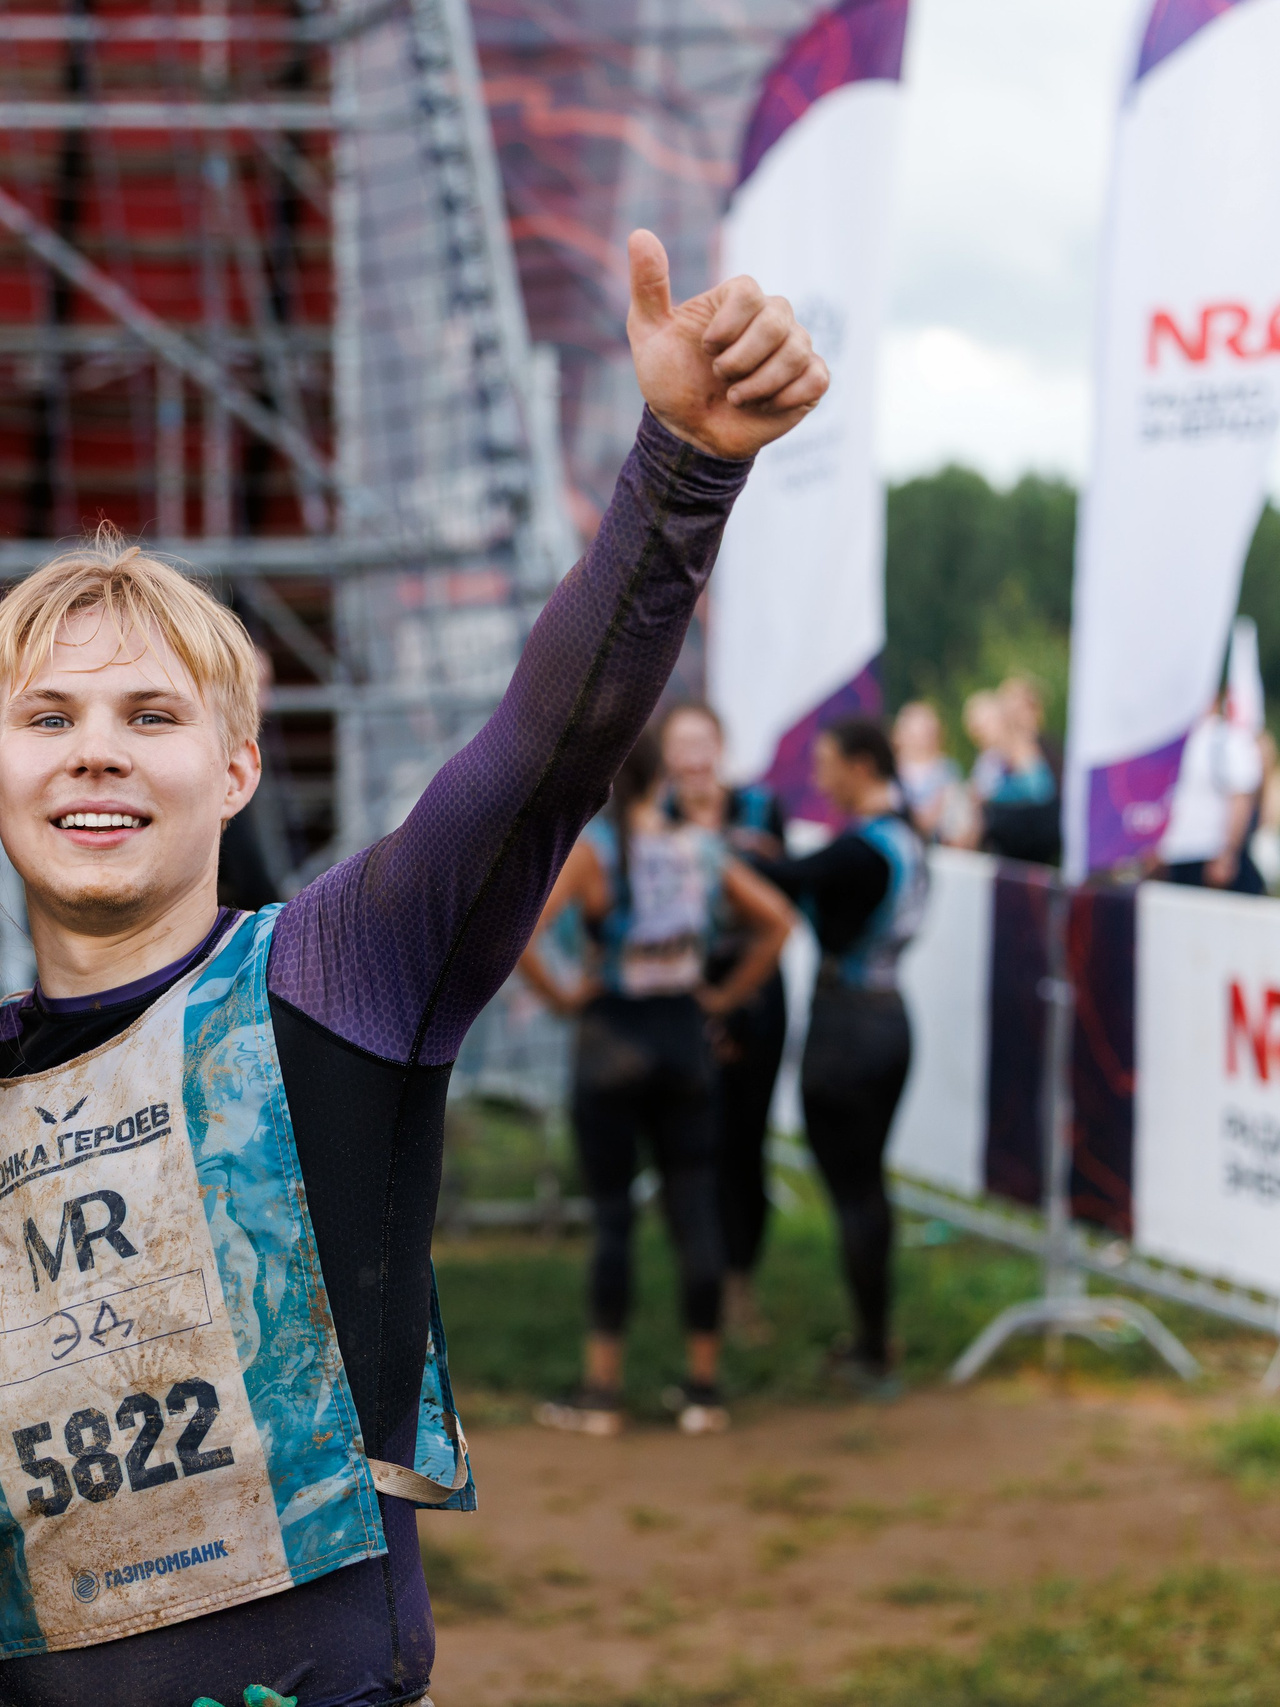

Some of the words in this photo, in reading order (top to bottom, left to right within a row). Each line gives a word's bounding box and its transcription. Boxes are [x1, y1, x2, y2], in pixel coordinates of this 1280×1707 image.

[1146, 303, 1280, 371] NR
[56, 1102, 171, 1159] ГЕРОЕВ
[22, 1190, 140, 1293] MR
[46, 1300, 135, 1361] ЭД
[11, 1377, 236, 1519] 5822
[104, 1540, 229, 1590] ГАЗПРОМБАНК
